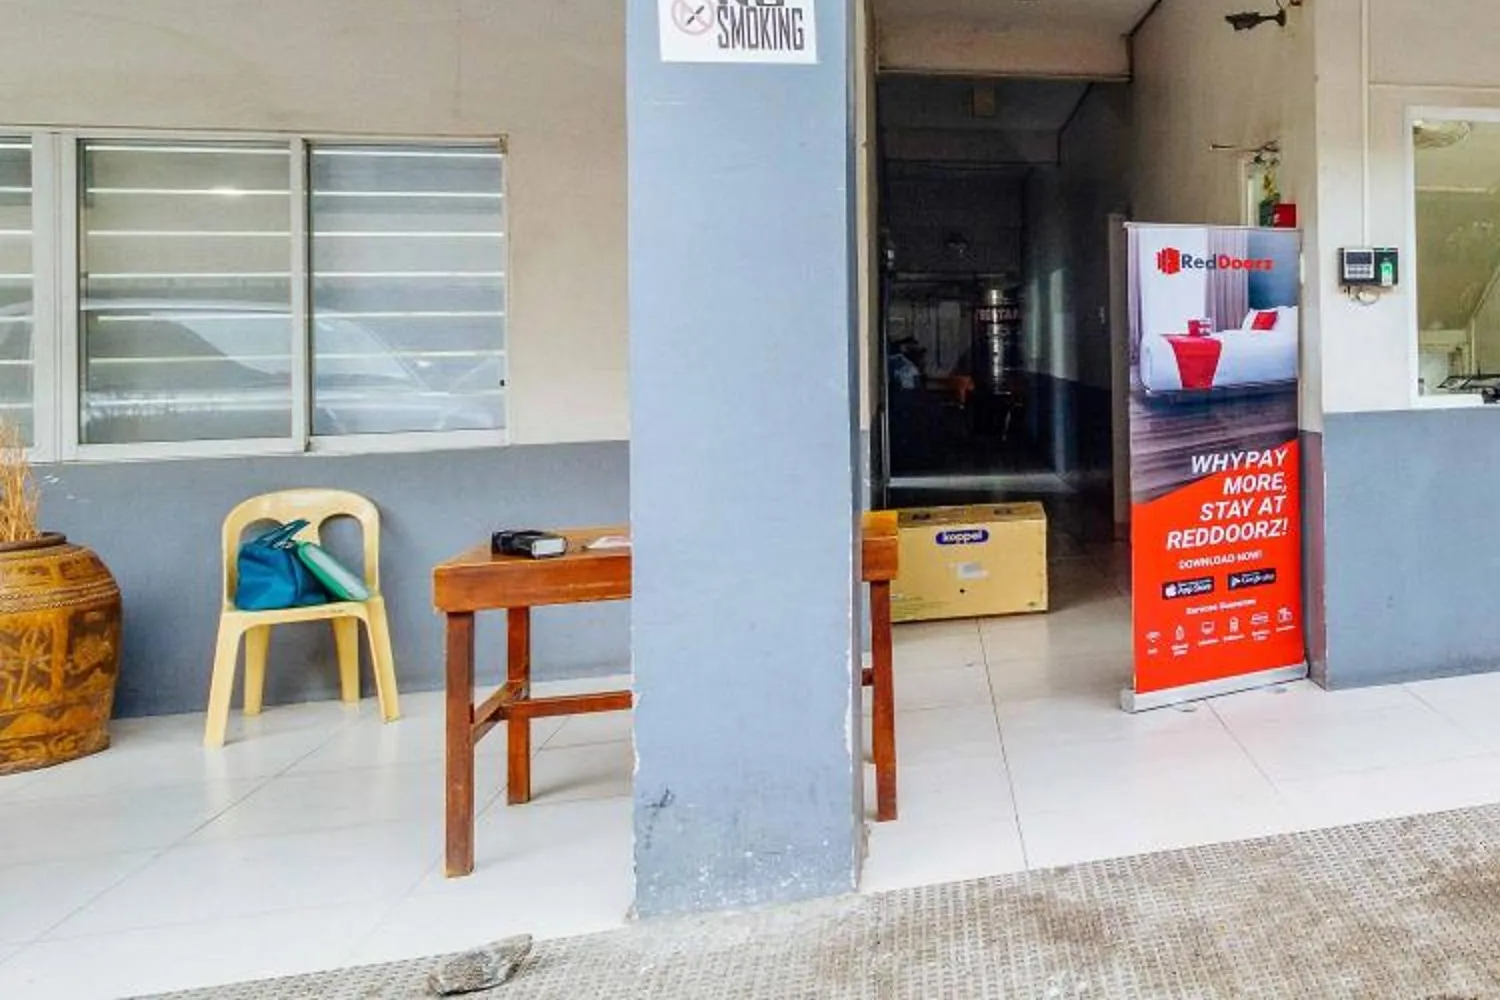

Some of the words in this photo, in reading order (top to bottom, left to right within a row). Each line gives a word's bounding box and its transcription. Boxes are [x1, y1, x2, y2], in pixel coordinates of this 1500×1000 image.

[717, 5, 805, 51] SMOKING
[1191, 450, 1244, 475] WHY
[1245, 447, 1288, 470] PAY
[1200, 497, 1254, 522] STAY
[1257, 495, 1287, 516] AT
[1166, 517, 1288, 551] REDDOORZ!
[1178, 552, 1236, 569] DOWNLOAD
